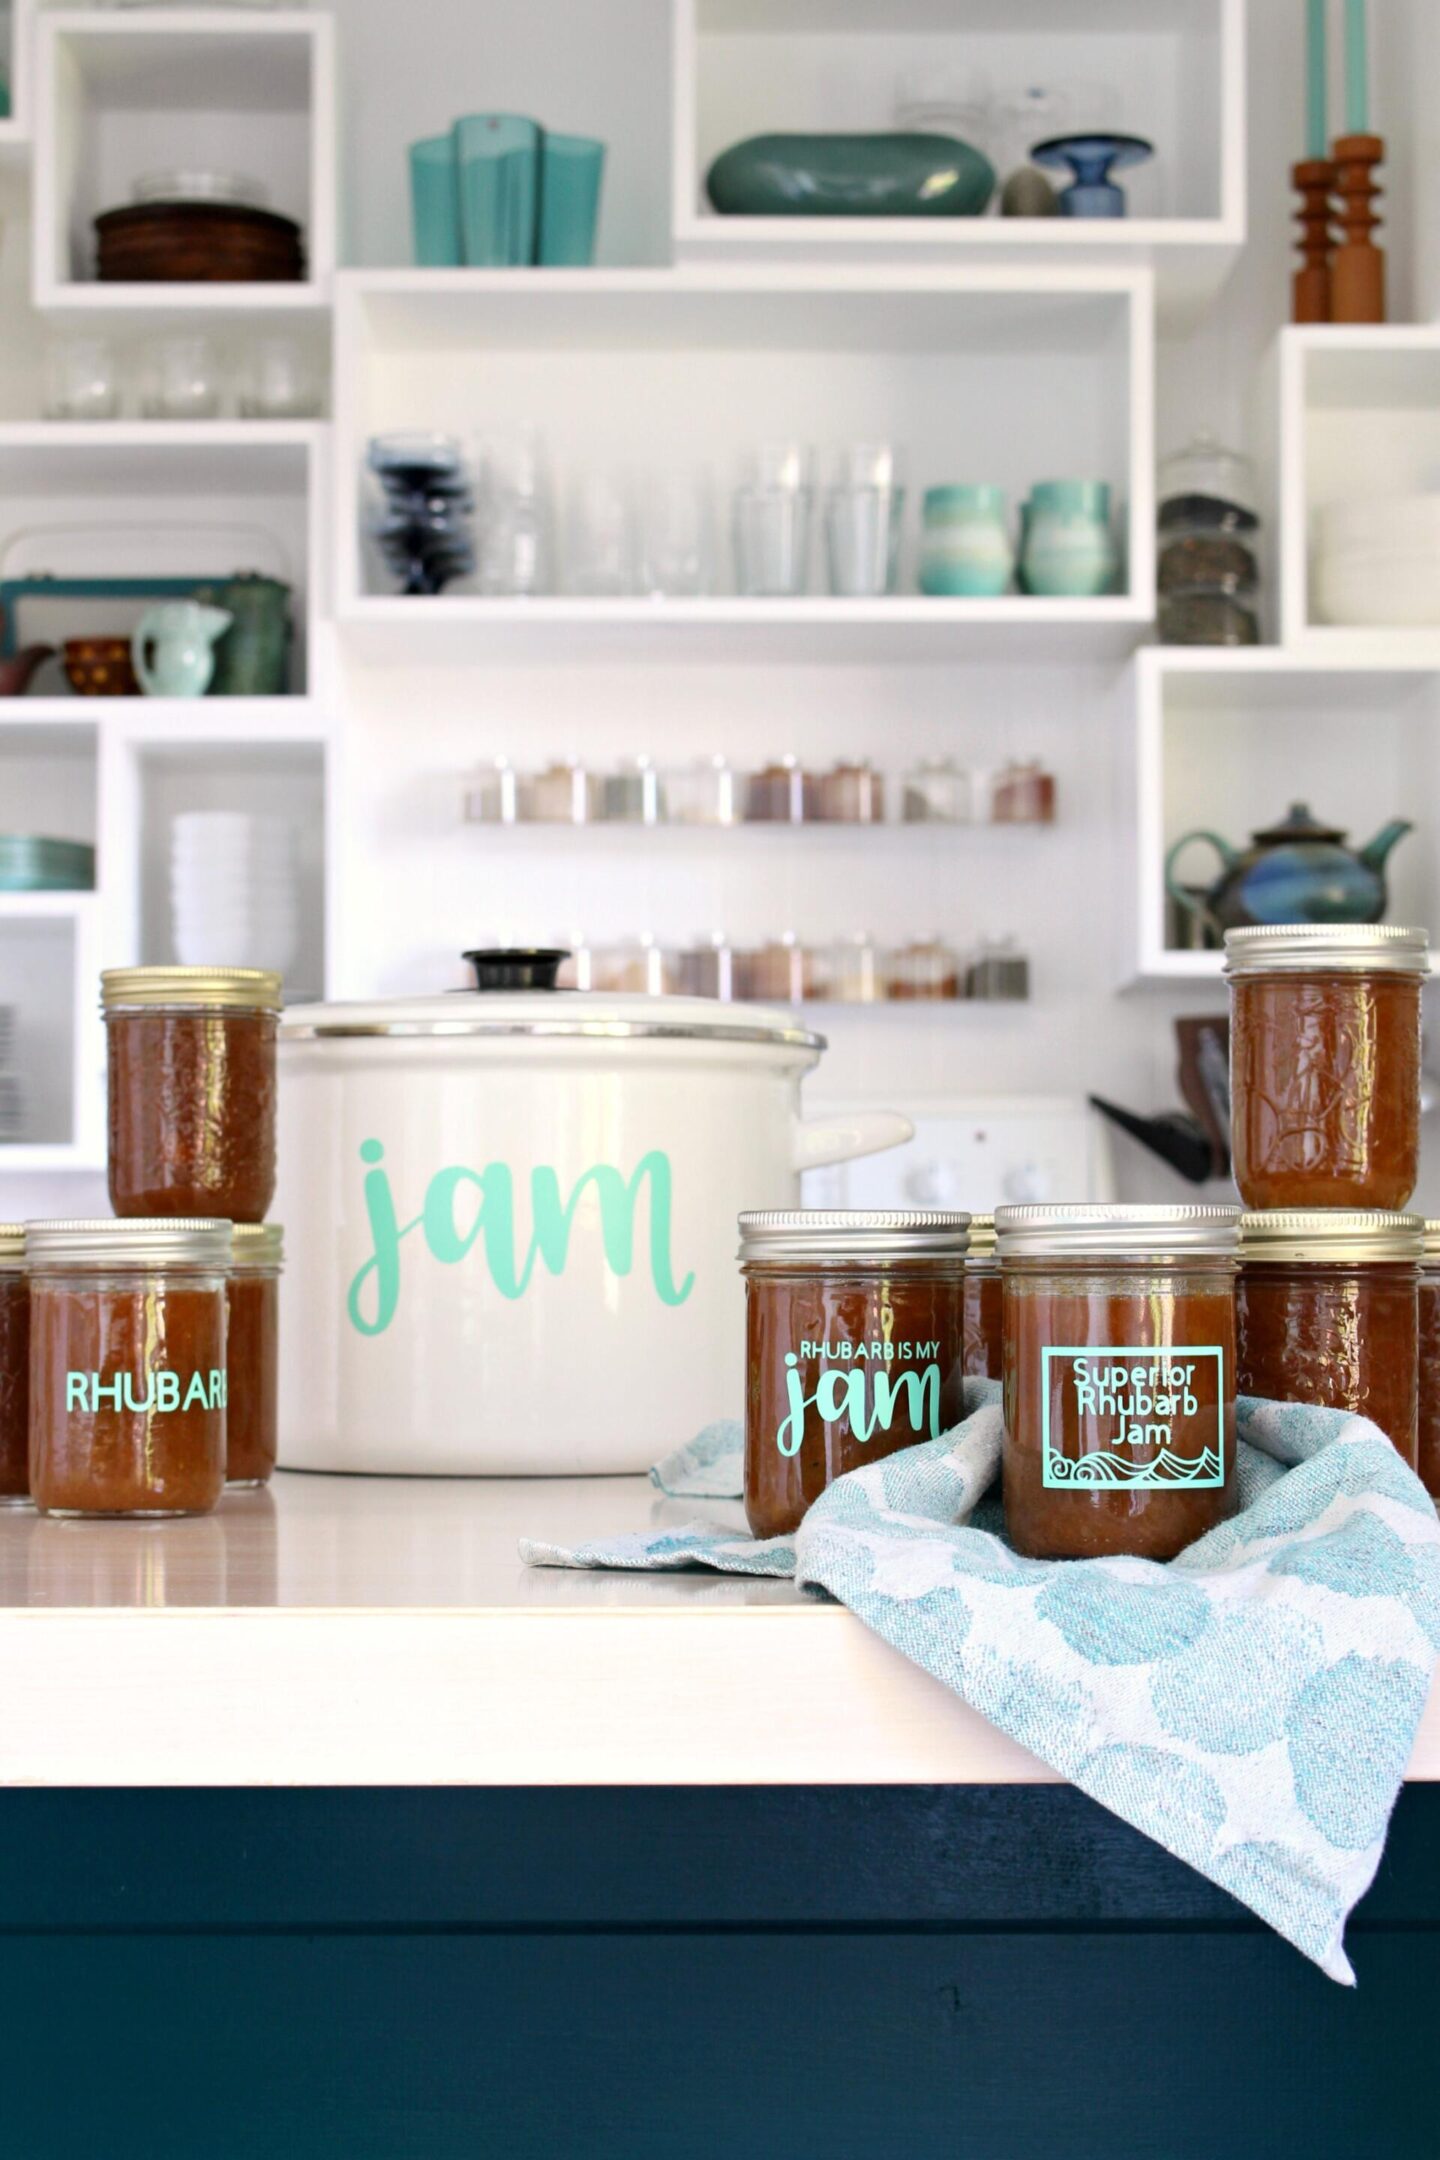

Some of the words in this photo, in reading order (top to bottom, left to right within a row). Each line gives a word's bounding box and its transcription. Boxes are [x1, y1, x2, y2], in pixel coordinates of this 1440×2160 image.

[347, 1138, 696, 1337] jam
[800, 1340, 895, 1360] RHUBARB
[898, 1341, 912, 1359] IS
[915, 1340, 941, 1359] MY
[1073, 1357, 1196, 1393] Superior
[776, 1352, 949, 1457] jam
[1077, 1384, 1199, 1416] Rhubarb
[1111, 1414, 1172, 1445] Jam
